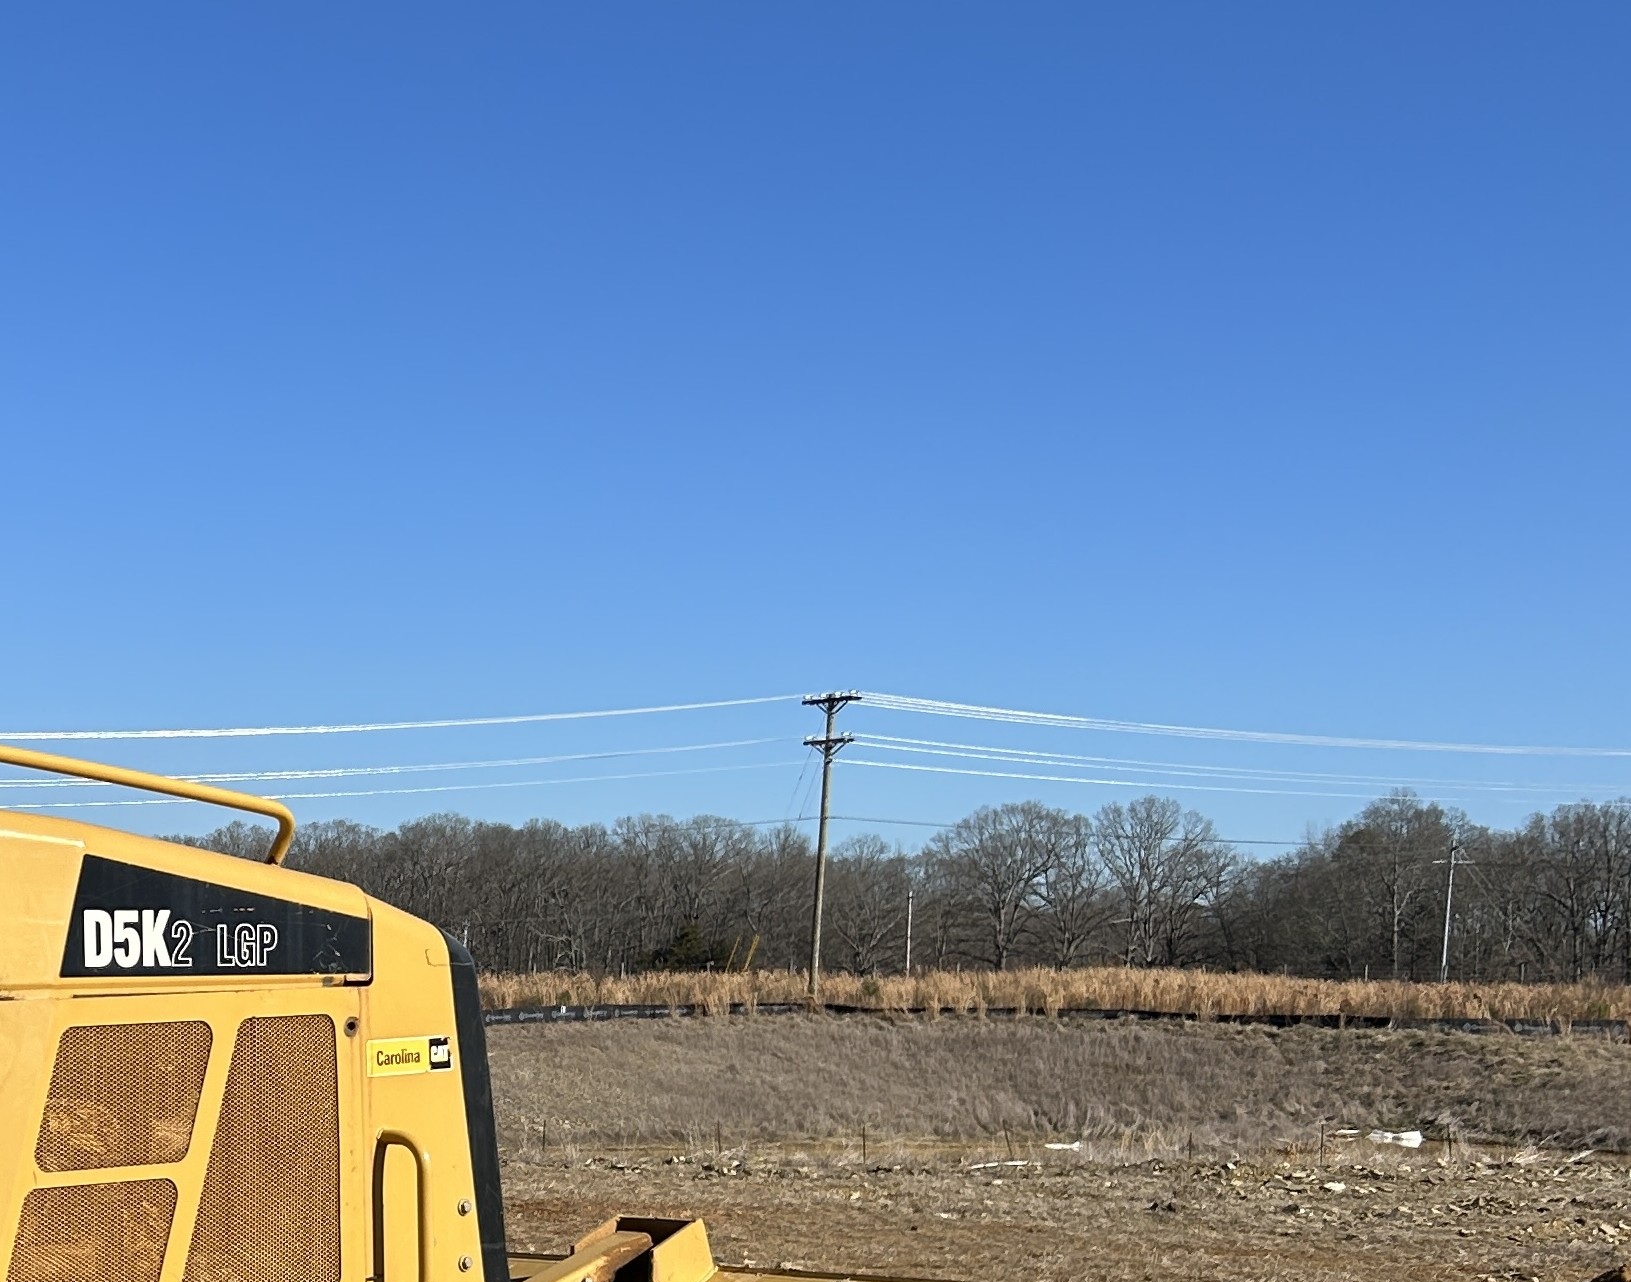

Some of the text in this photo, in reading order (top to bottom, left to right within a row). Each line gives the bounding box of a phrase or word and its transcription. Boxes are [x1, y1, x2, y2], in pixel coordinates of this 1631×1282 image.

[216, 923, 278, 967] LGP
[376, 1044, 450, 1066] Carolina CAT
